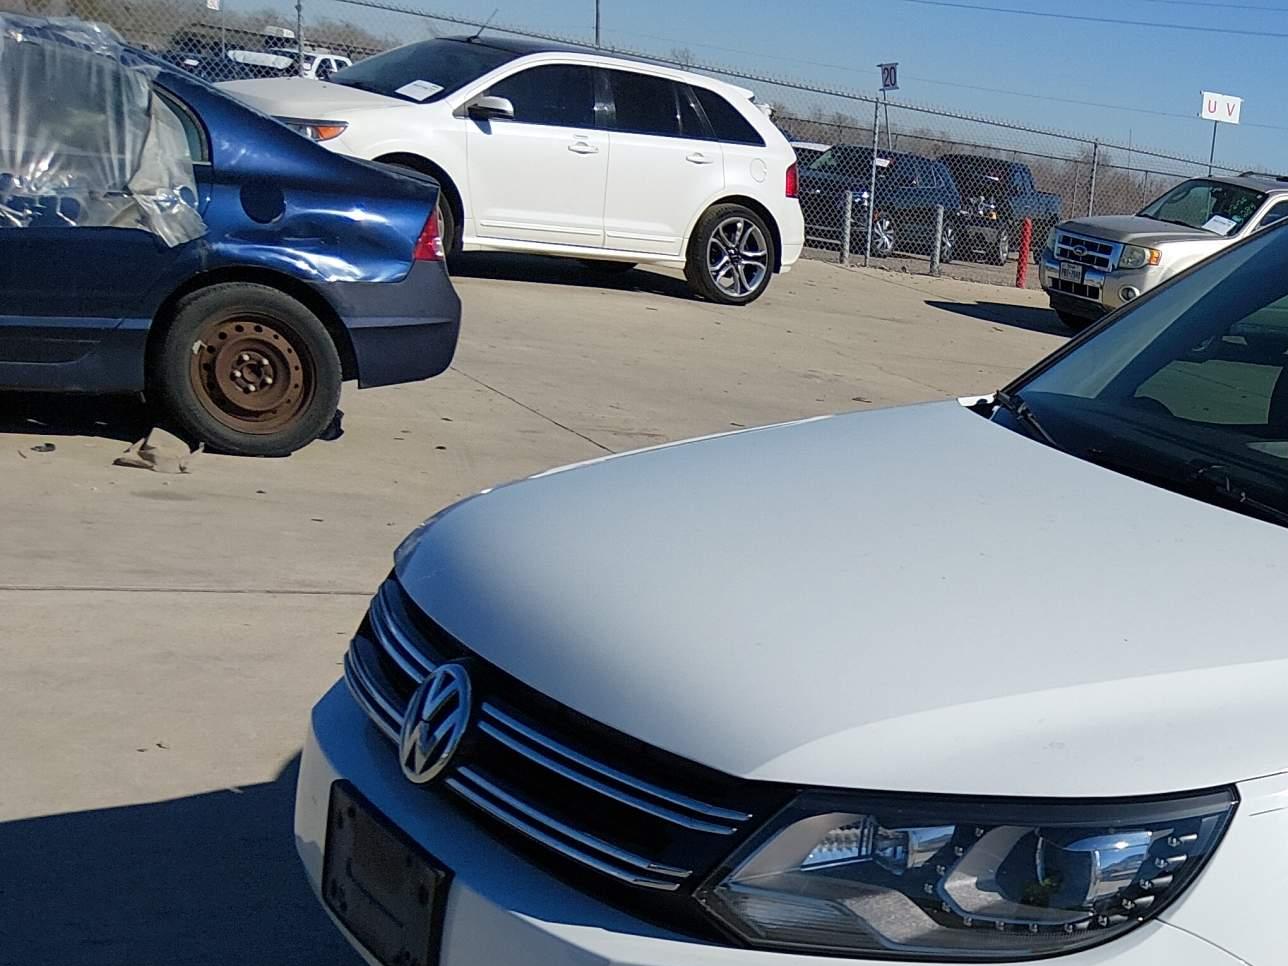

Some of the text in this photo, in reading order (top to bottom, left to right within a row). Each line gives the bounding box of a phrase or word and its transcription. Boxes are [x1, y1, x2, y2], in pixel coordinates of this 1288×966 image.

[883, 66, 897, 87] 20
[1208, 99, 1236, 117] U V
